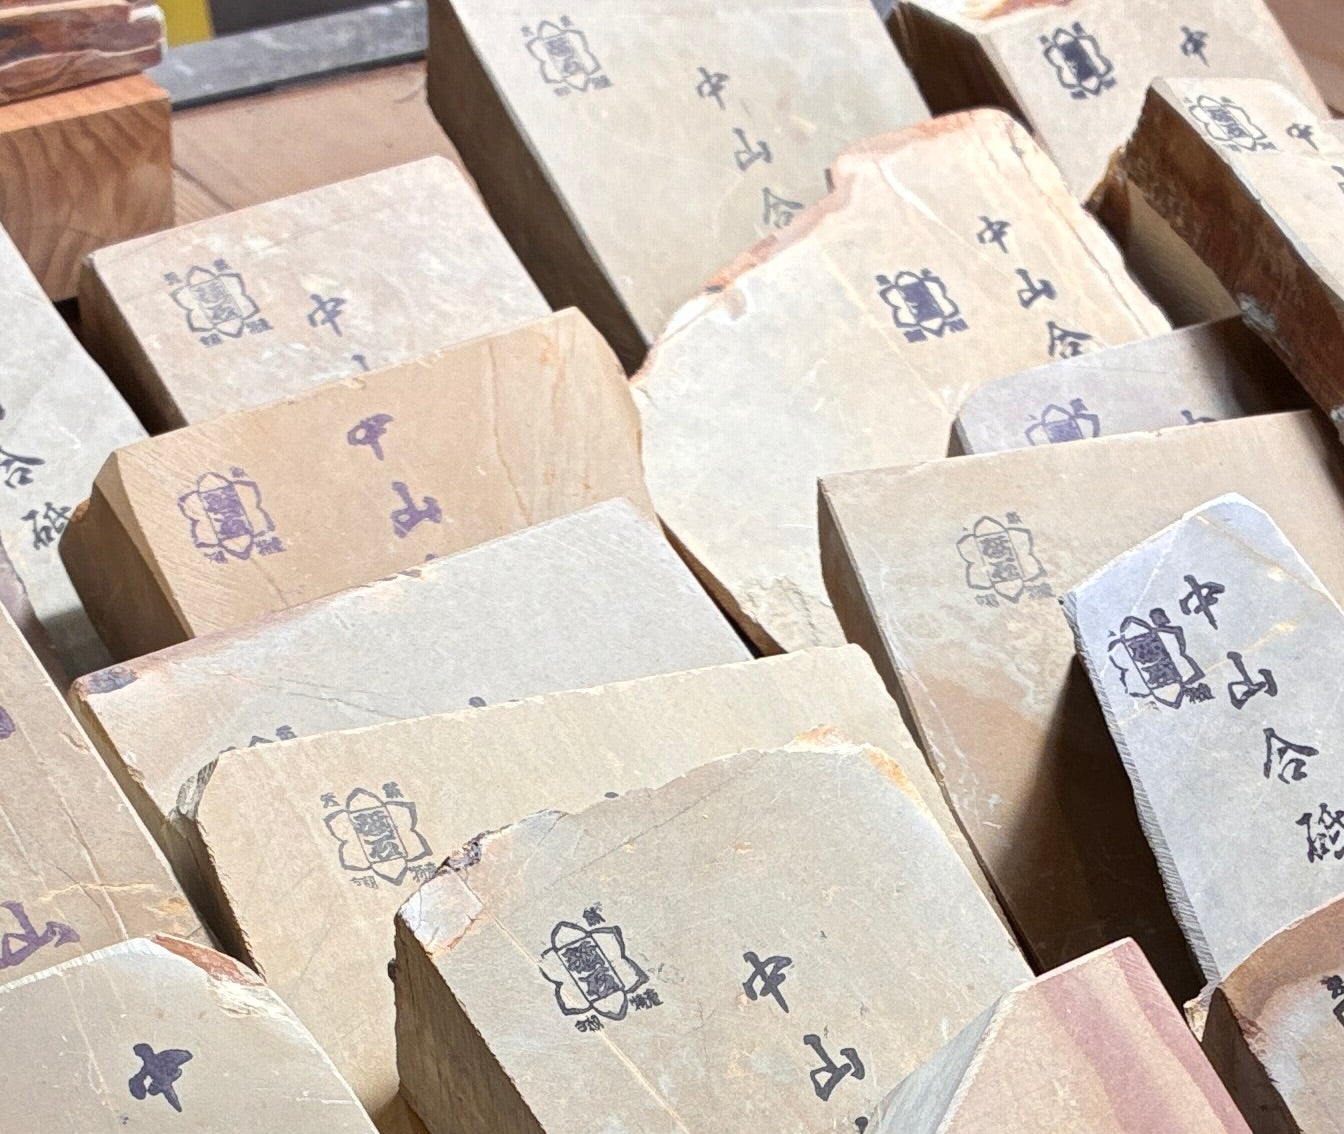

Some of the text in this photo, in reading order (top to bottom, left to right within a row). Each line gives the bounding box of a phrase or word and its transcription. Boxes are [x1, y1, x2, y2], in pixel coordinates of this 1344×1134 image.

[1180, 25, 1210, 67] 中
[696, 67, 805, 229] 中山合
[307, 294, 371, 370] 中
[976, 215, 1093, 359] 中山合
[347, 414, 443, 561] 中山
